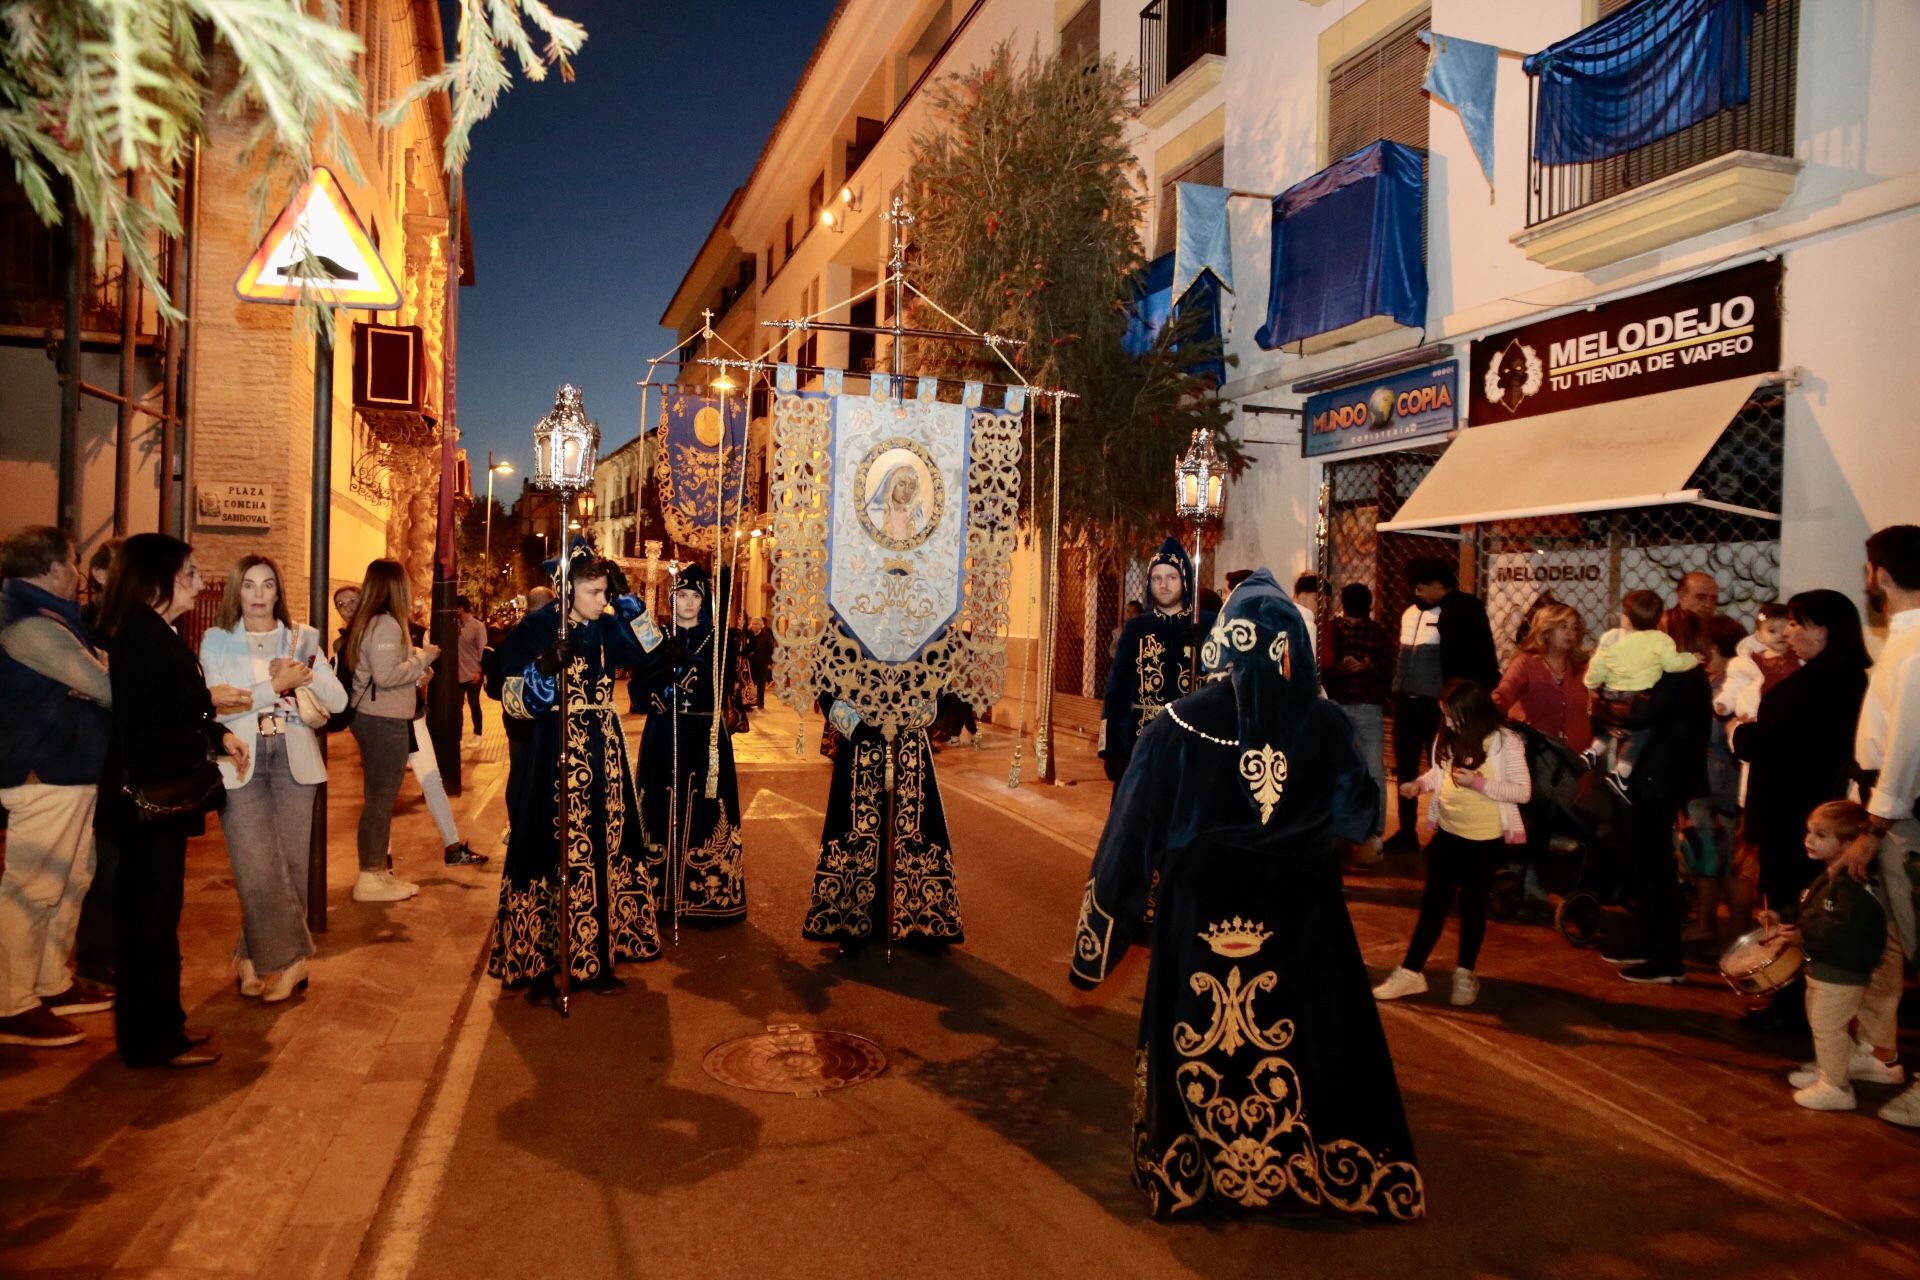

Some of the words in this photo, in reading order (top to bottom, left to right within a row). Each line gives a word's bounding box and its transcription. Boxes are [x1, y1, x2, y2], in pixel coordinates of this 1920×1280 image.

[1550, 296, 1755, 369] MELODEJO
[1549, 374, 1572, 392] TU
[1576, 360, 1643, 386] TIENDA
[1647, 352, 1675, 372] DE
[1679, 336, 1754, 364] VAPEO
[1312, 402, 1368, 434] MUNDO
[1396, 383, 1453, 417] COPIA
[228, 486, 264, 496] PLAZA
[224, 500, 266, 509] CONCHA
[222, 513, 269, 524] SANDOVAL
[1497, 564, 1601, 582] MELODEJO
